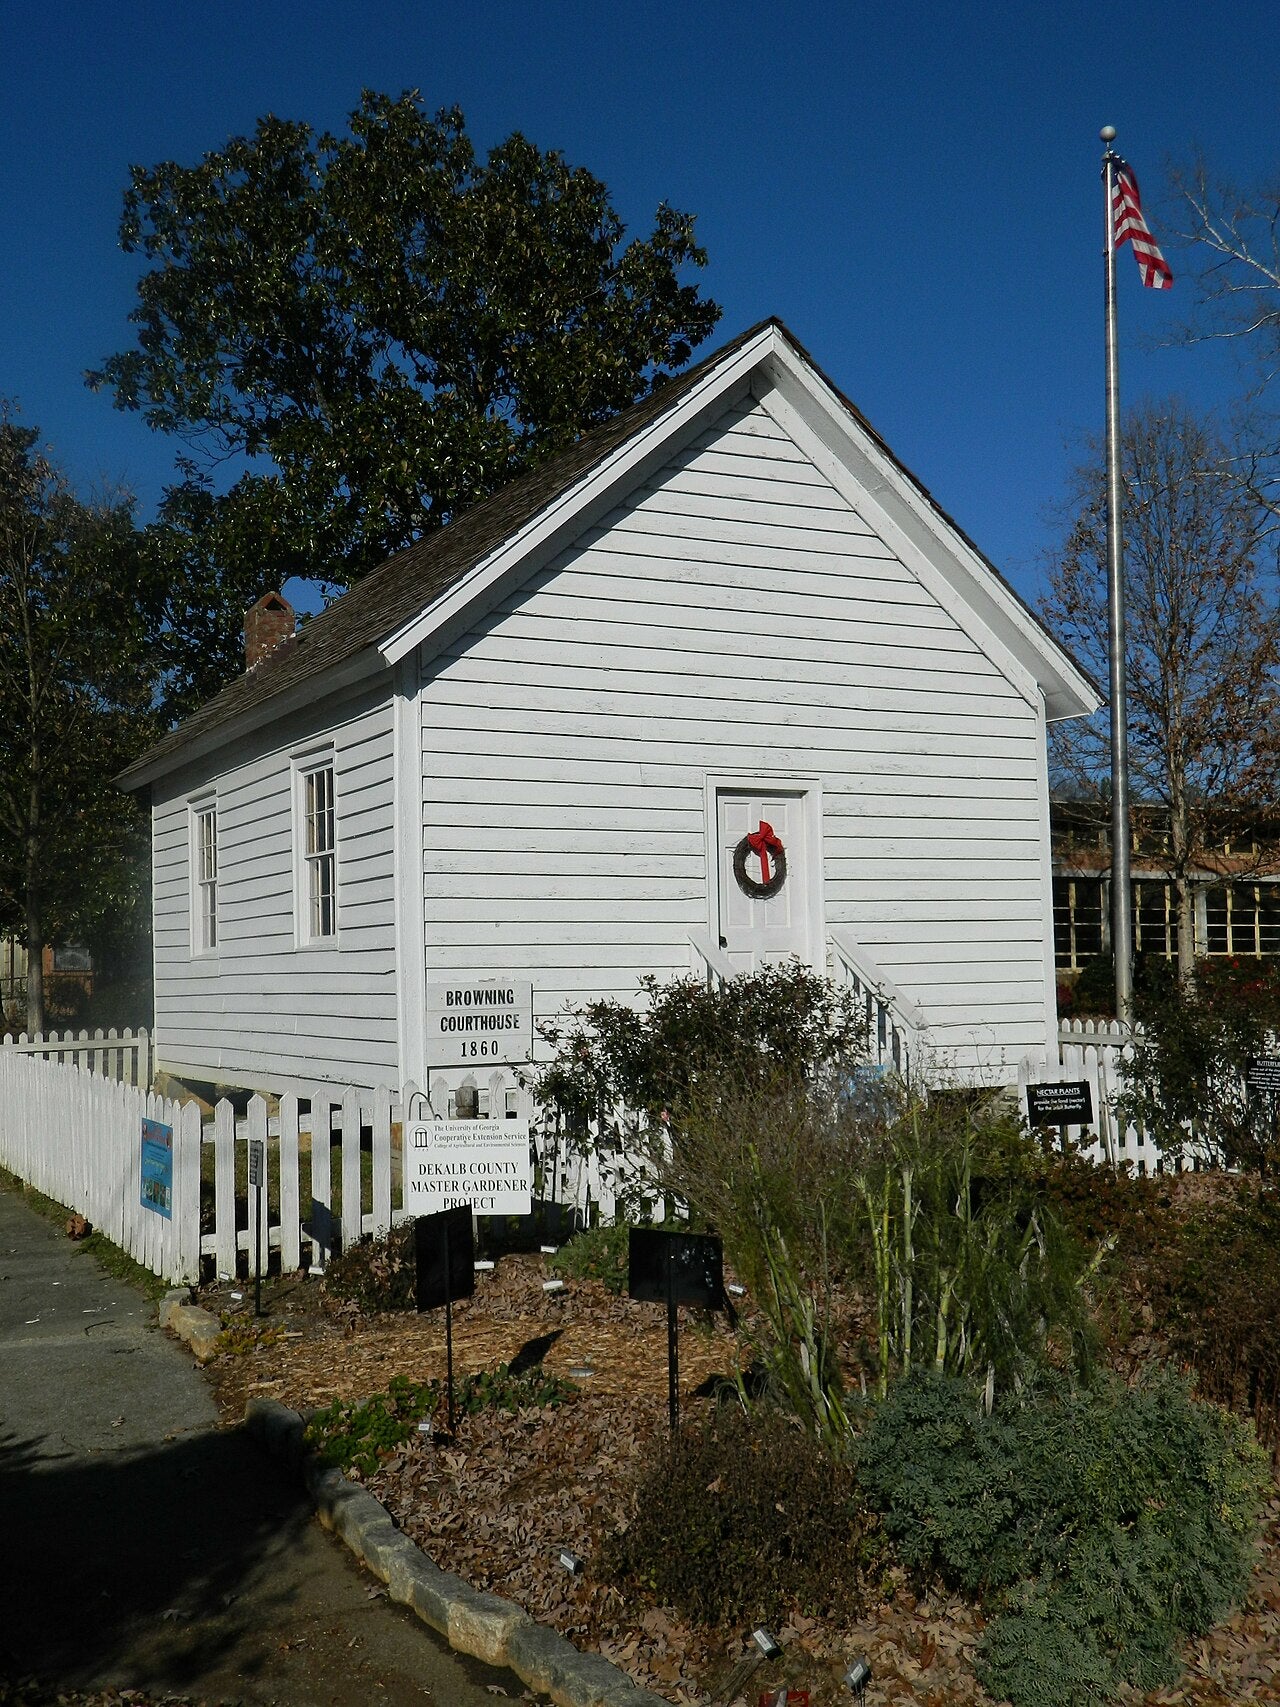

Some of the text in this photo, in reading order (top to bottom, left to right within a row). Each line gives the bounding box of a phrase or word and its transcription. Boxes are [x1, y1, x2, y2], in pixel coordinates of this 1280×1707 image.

[446, 989, 514, 1006] BROWNING
[440, 1014, 520, 1032] COURTHOUSE
[461, 1040, 498, 1057] 1860
[434, 1134, 471, 1142] Cooperative
[419, 1162, 518, 1175] DEKALB COUNTY
[411, 1180, 528, 1192] MASTER GARDENER
